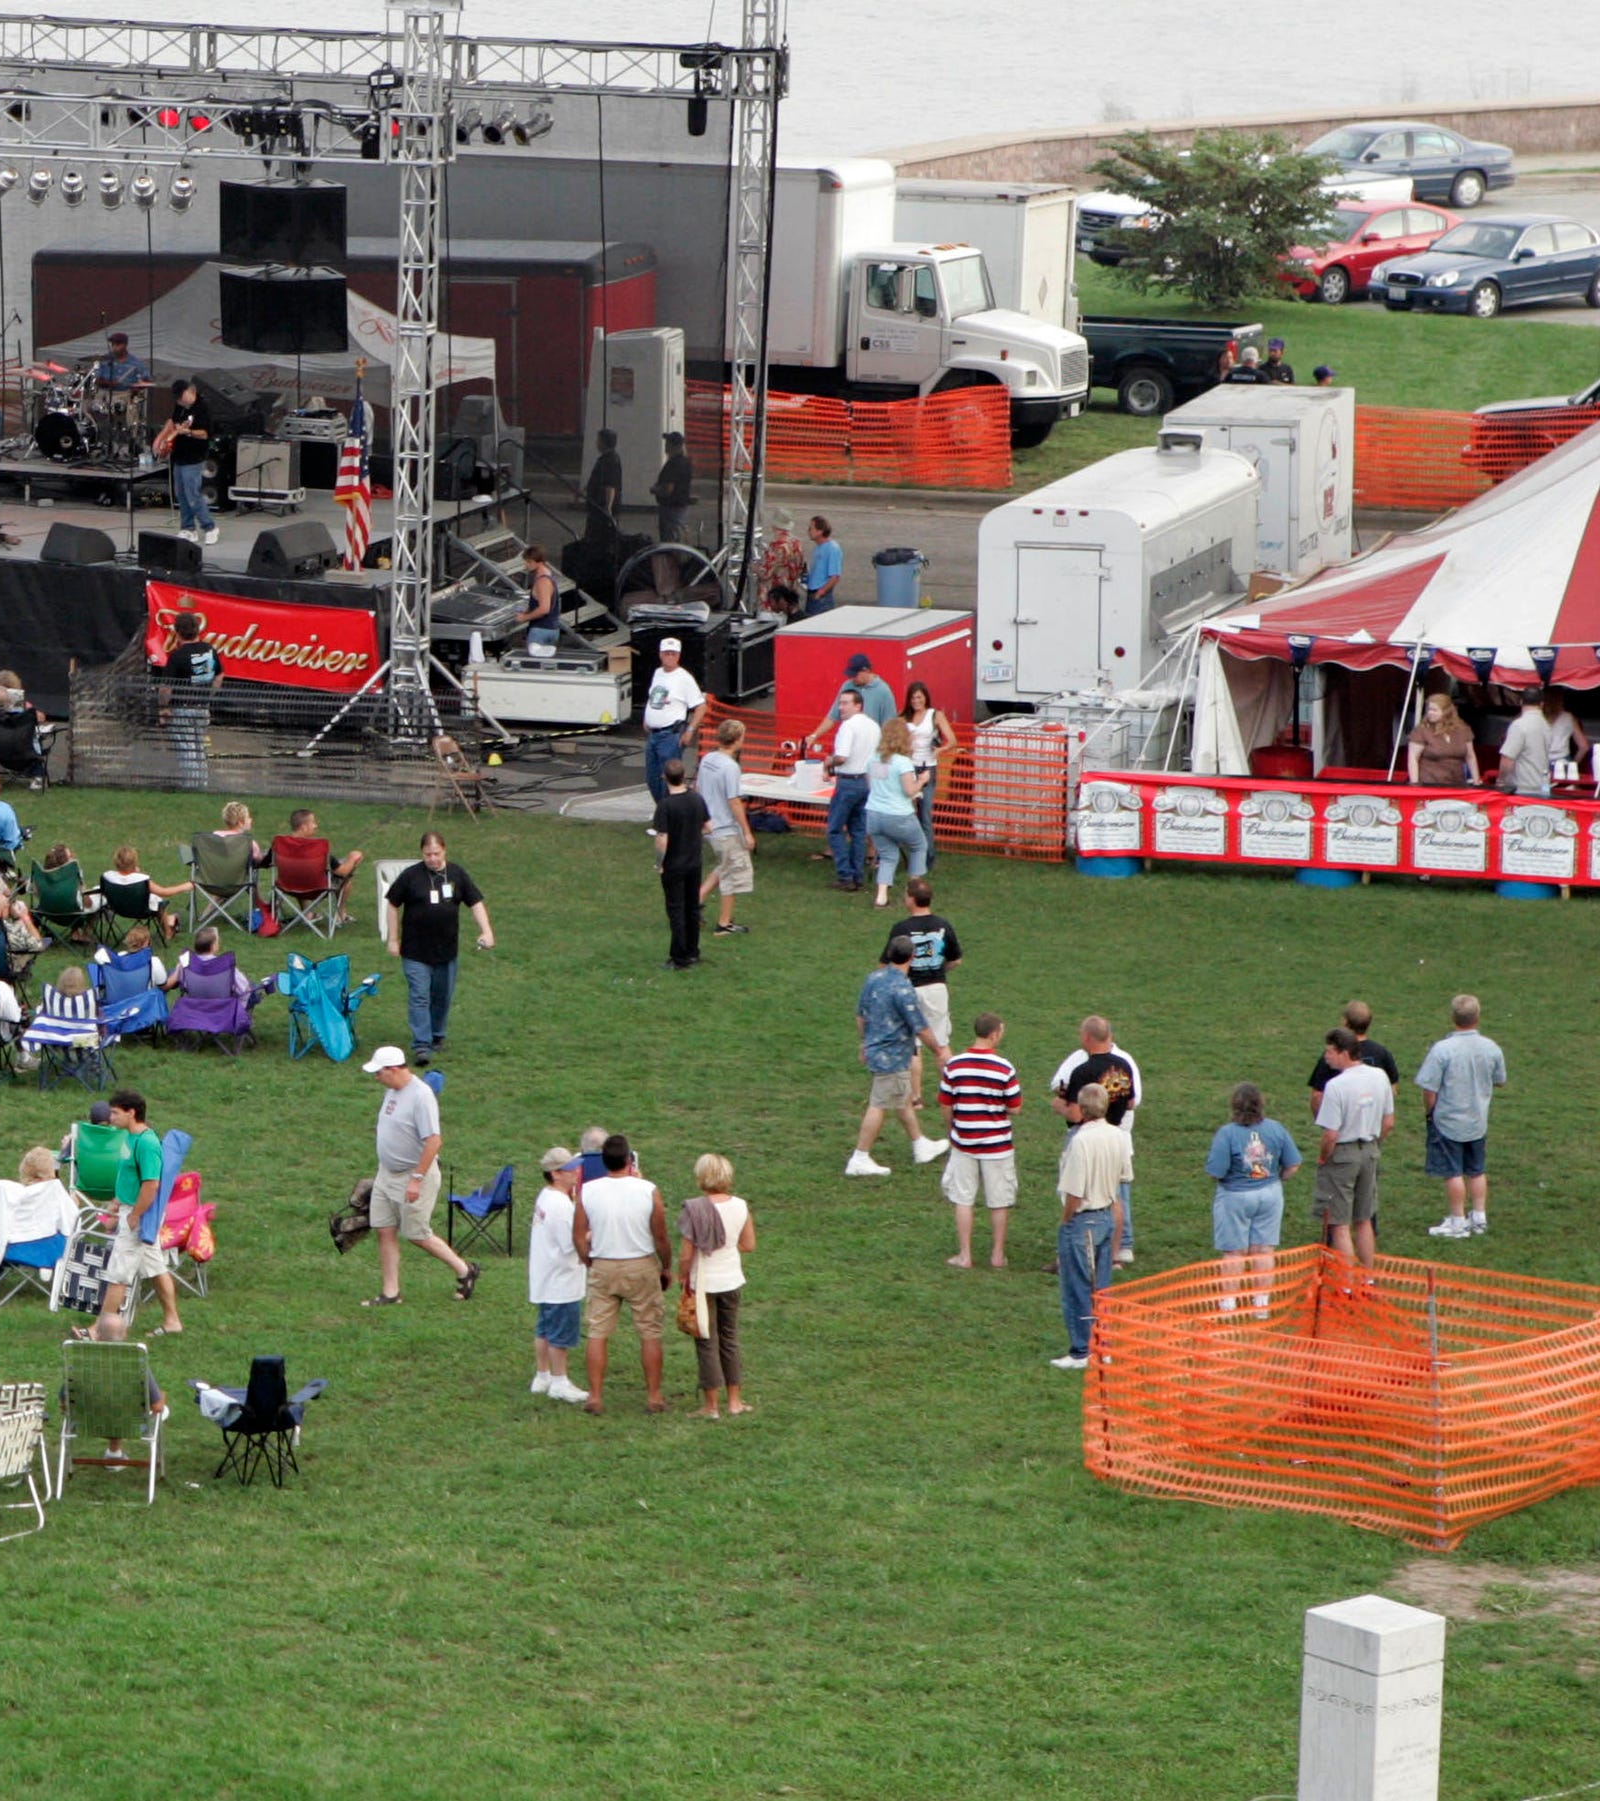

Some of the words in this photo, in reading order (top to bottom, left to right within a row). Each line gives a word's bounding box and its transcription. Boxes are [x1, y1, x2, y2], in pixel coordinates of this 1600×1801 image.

[1077, 814, 1136, 829] Budweiser
[1159, 816, 1220, 833] Budweiser
[1243, 821, 1306, 838] Budweiser
[1329, 826, 1393, 843] Budweiser
[1417, 832, 1481, 848] Budweiser
[1504, 838, 1569, 855] Budweiser
